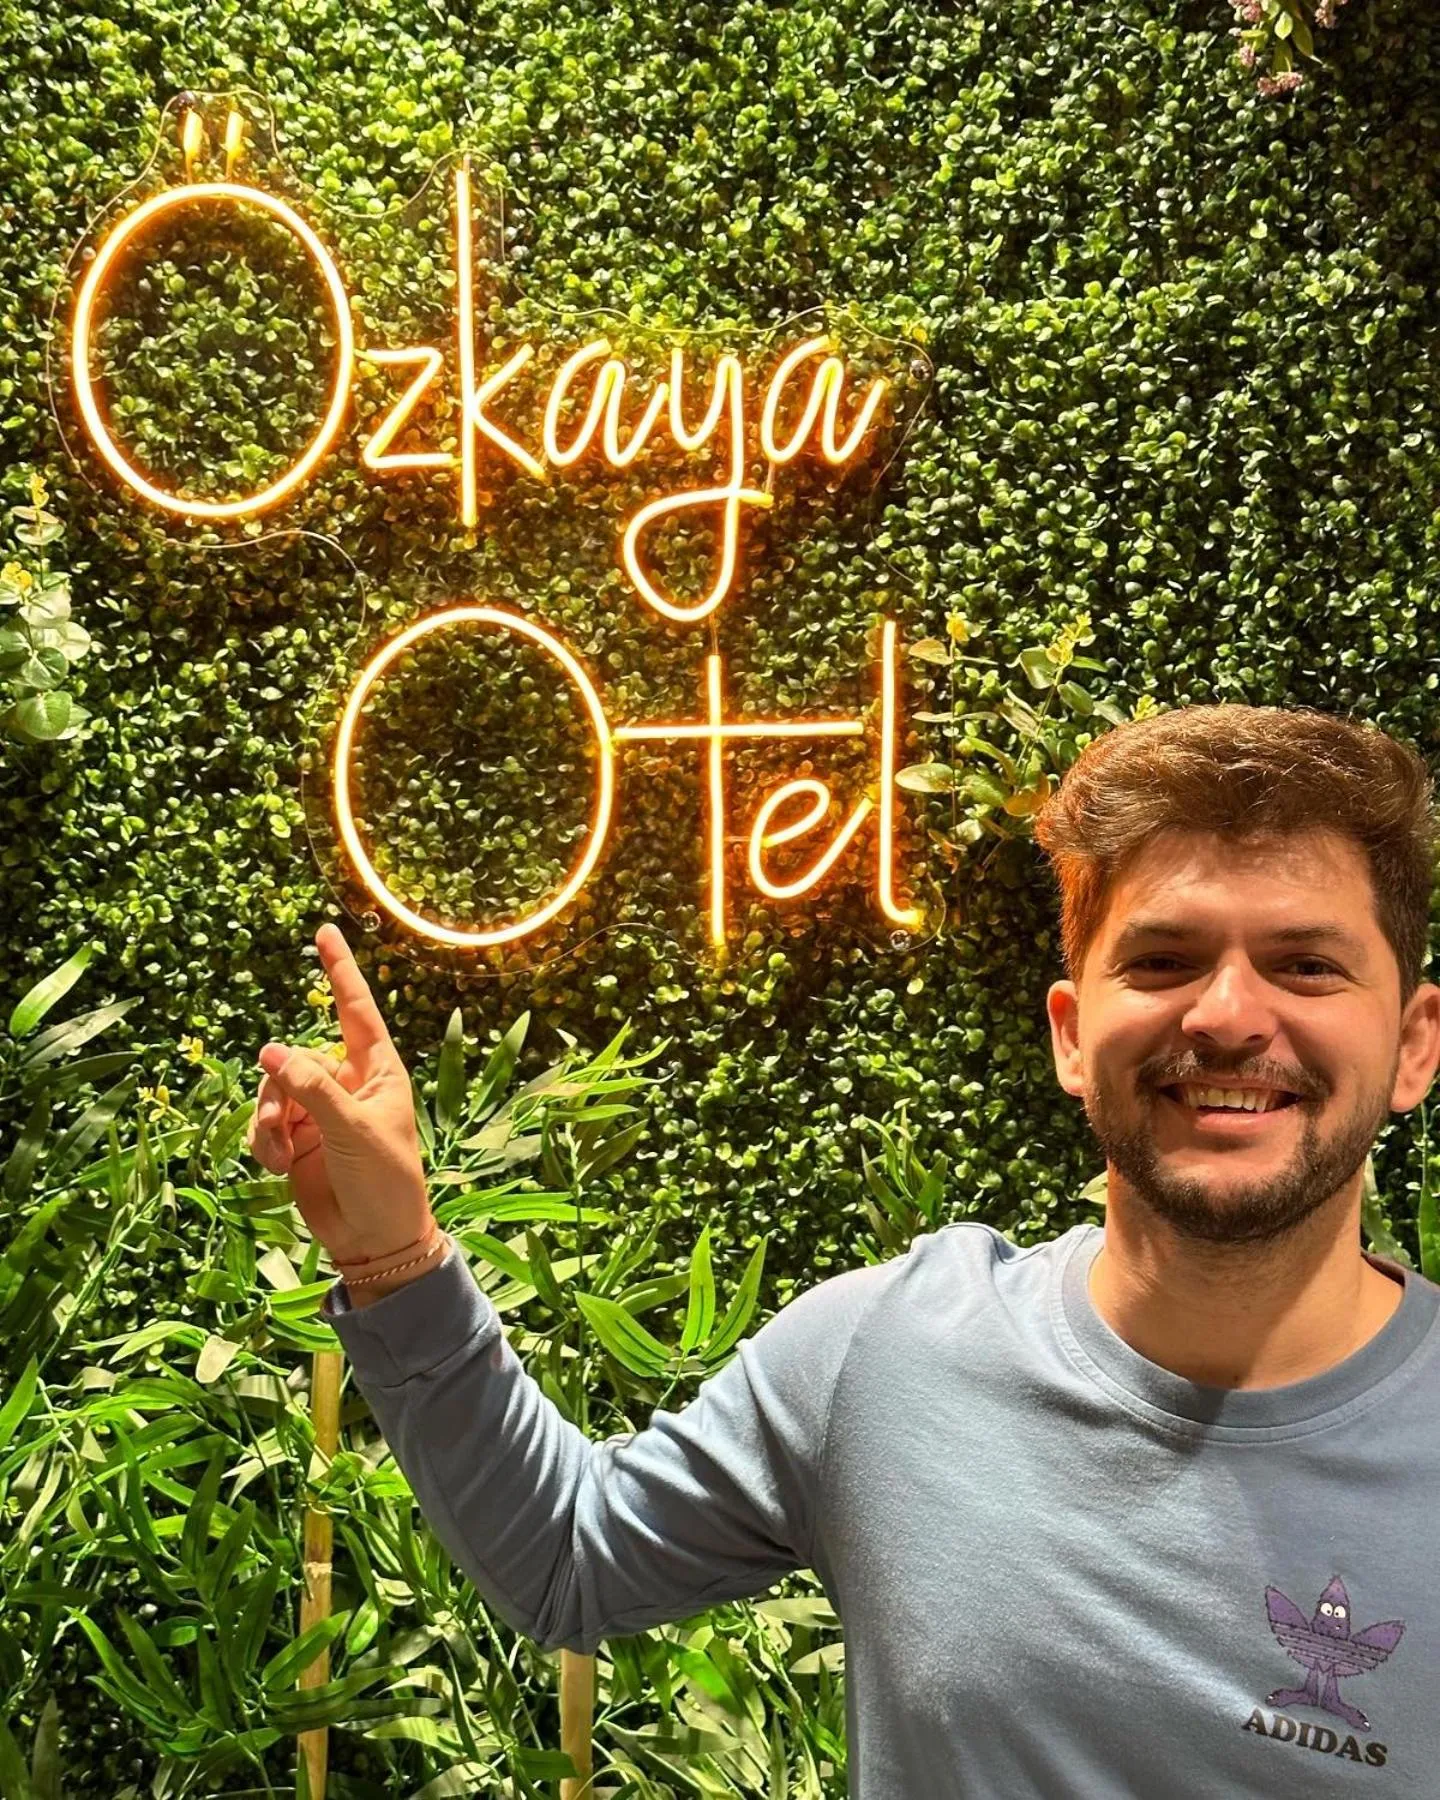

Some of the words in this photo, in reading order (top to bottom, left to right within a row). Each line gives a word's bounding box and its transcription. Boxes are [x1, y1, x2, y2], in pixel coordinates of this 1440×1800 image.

[71, 109, 888, 623] Özkaya
[334, 605, 924, 950] Otel
[1241, 1707, 1388, 1767] ADIDAS
